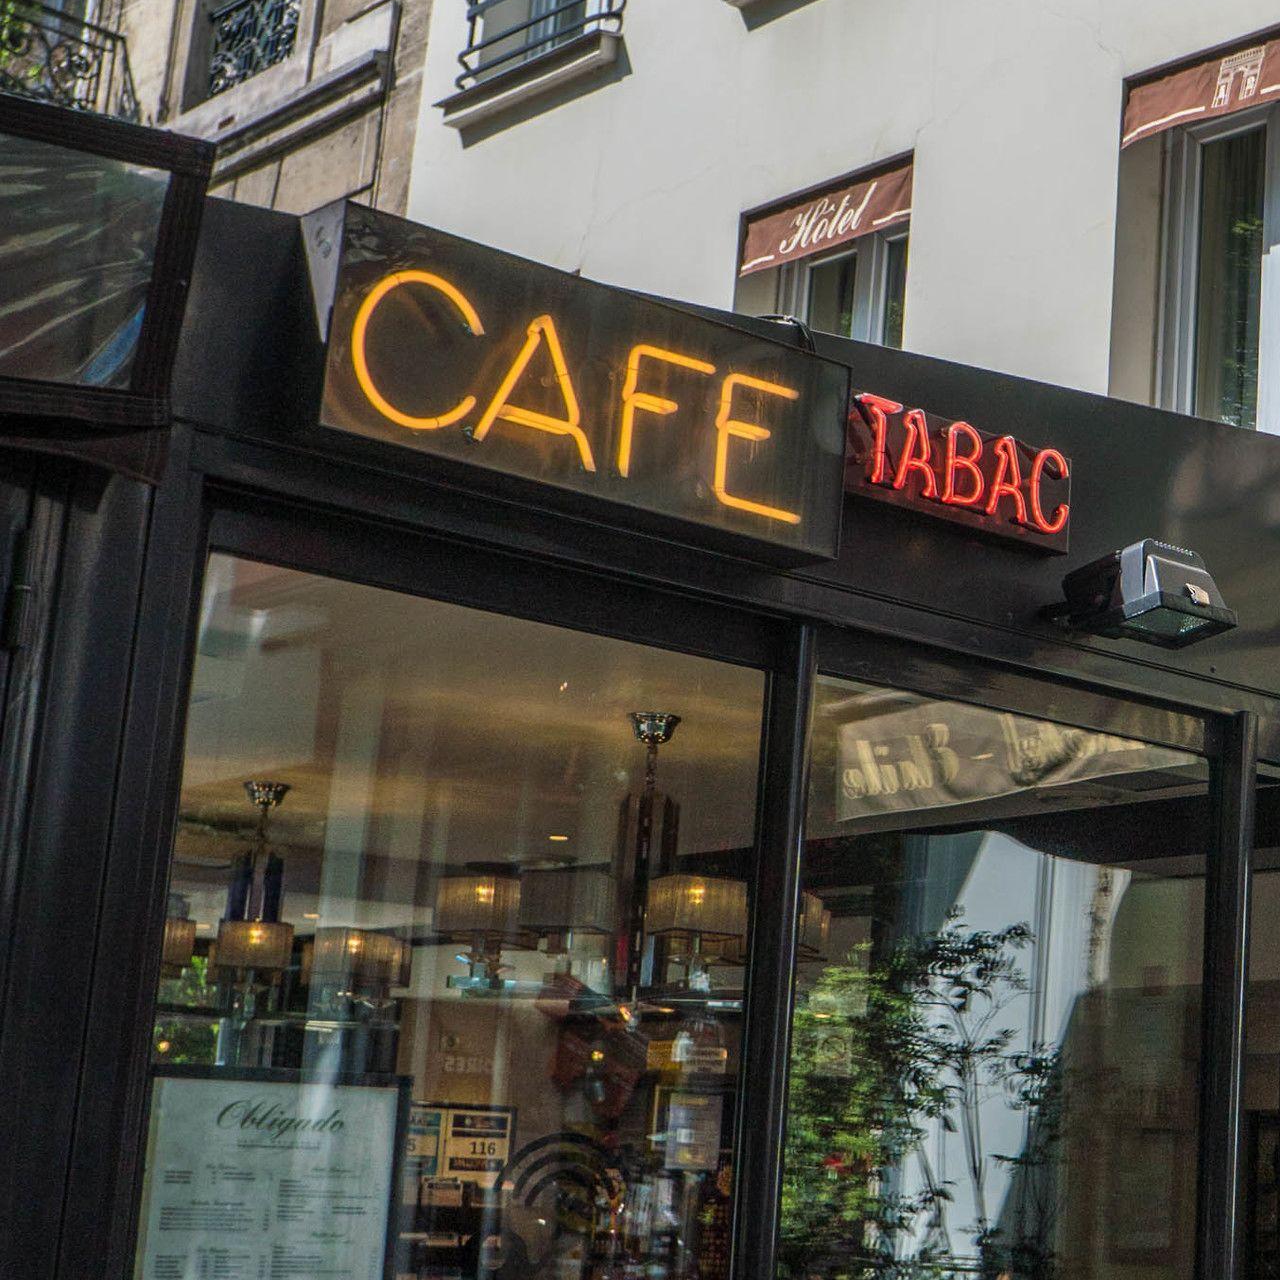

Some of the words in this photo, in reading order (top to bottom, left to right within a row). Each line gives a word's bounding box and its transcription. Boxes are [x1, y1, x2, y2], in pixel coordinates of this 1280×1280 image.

[778, 180, 879, 255] Hôtel
[350, 269, 801, 524] CAFE
[855, 392, 1071, 536] TABAC
